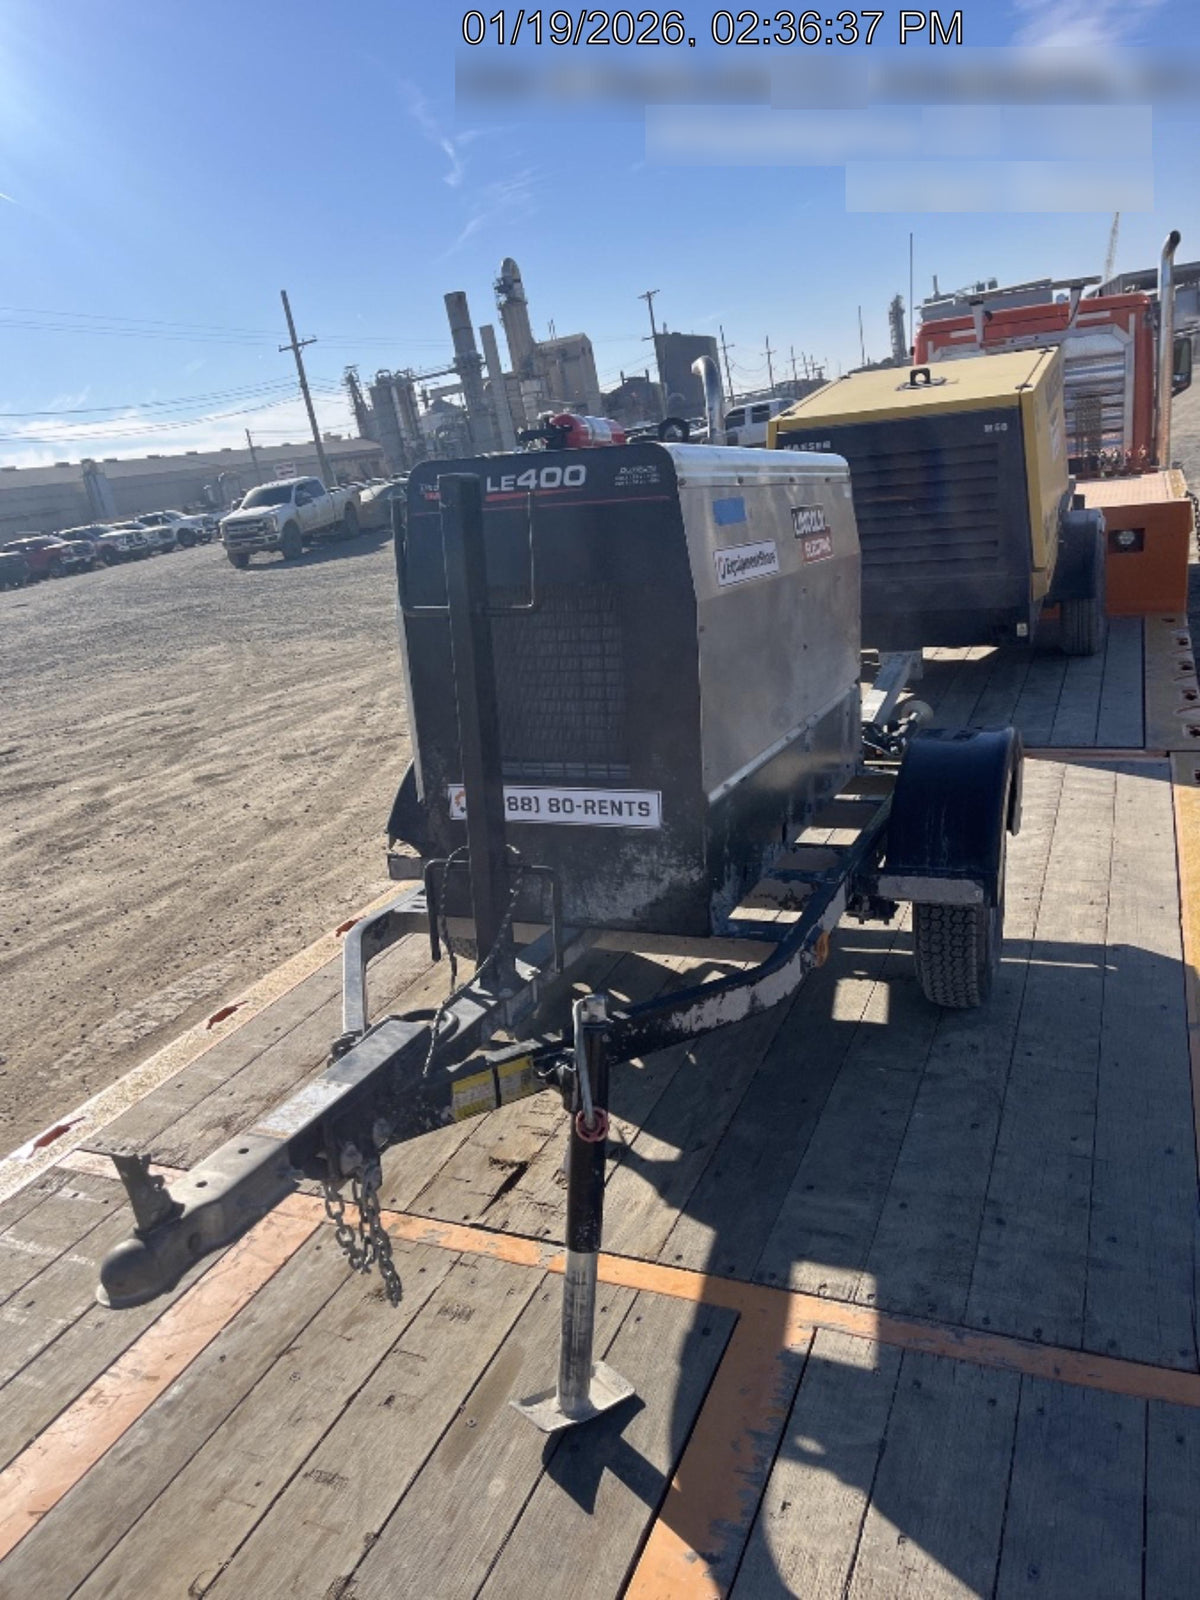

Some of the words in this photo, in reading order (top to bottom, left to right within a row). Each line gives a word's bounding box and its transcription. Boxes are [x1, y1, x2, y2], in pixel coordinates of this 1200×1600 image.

[486, 464, 587, 492] LE400
[506, 795, 540, 812] 88)
[548, 797, 651, 816] 80-RENTS
